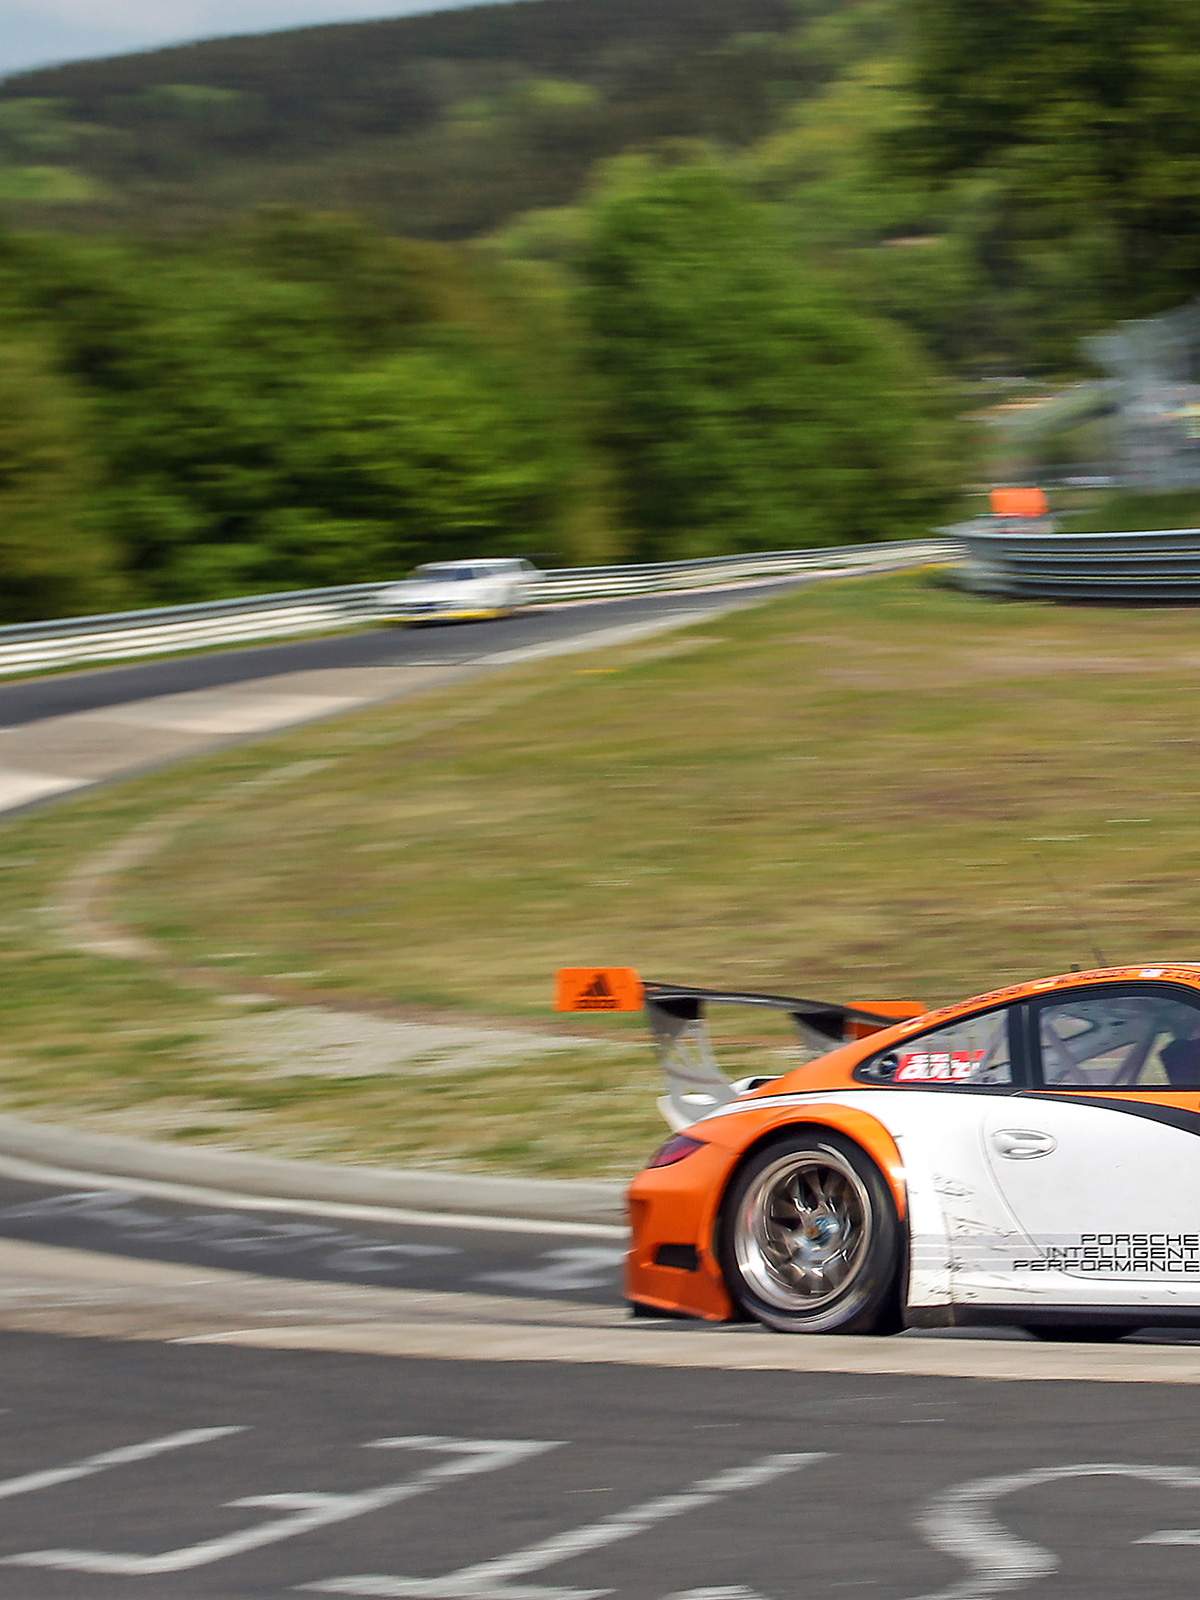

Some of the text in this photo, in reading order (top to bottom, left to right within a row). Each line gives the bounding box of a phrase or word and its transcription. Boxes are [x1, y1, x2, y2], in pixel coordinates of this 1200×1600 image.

[1080, 1233, 1200, 1246] PORSCHE
[1044, 1246, 1200, 1259] INTELLIGENT
[1012, 1259, 1200, 1273] PERFORMANCE
